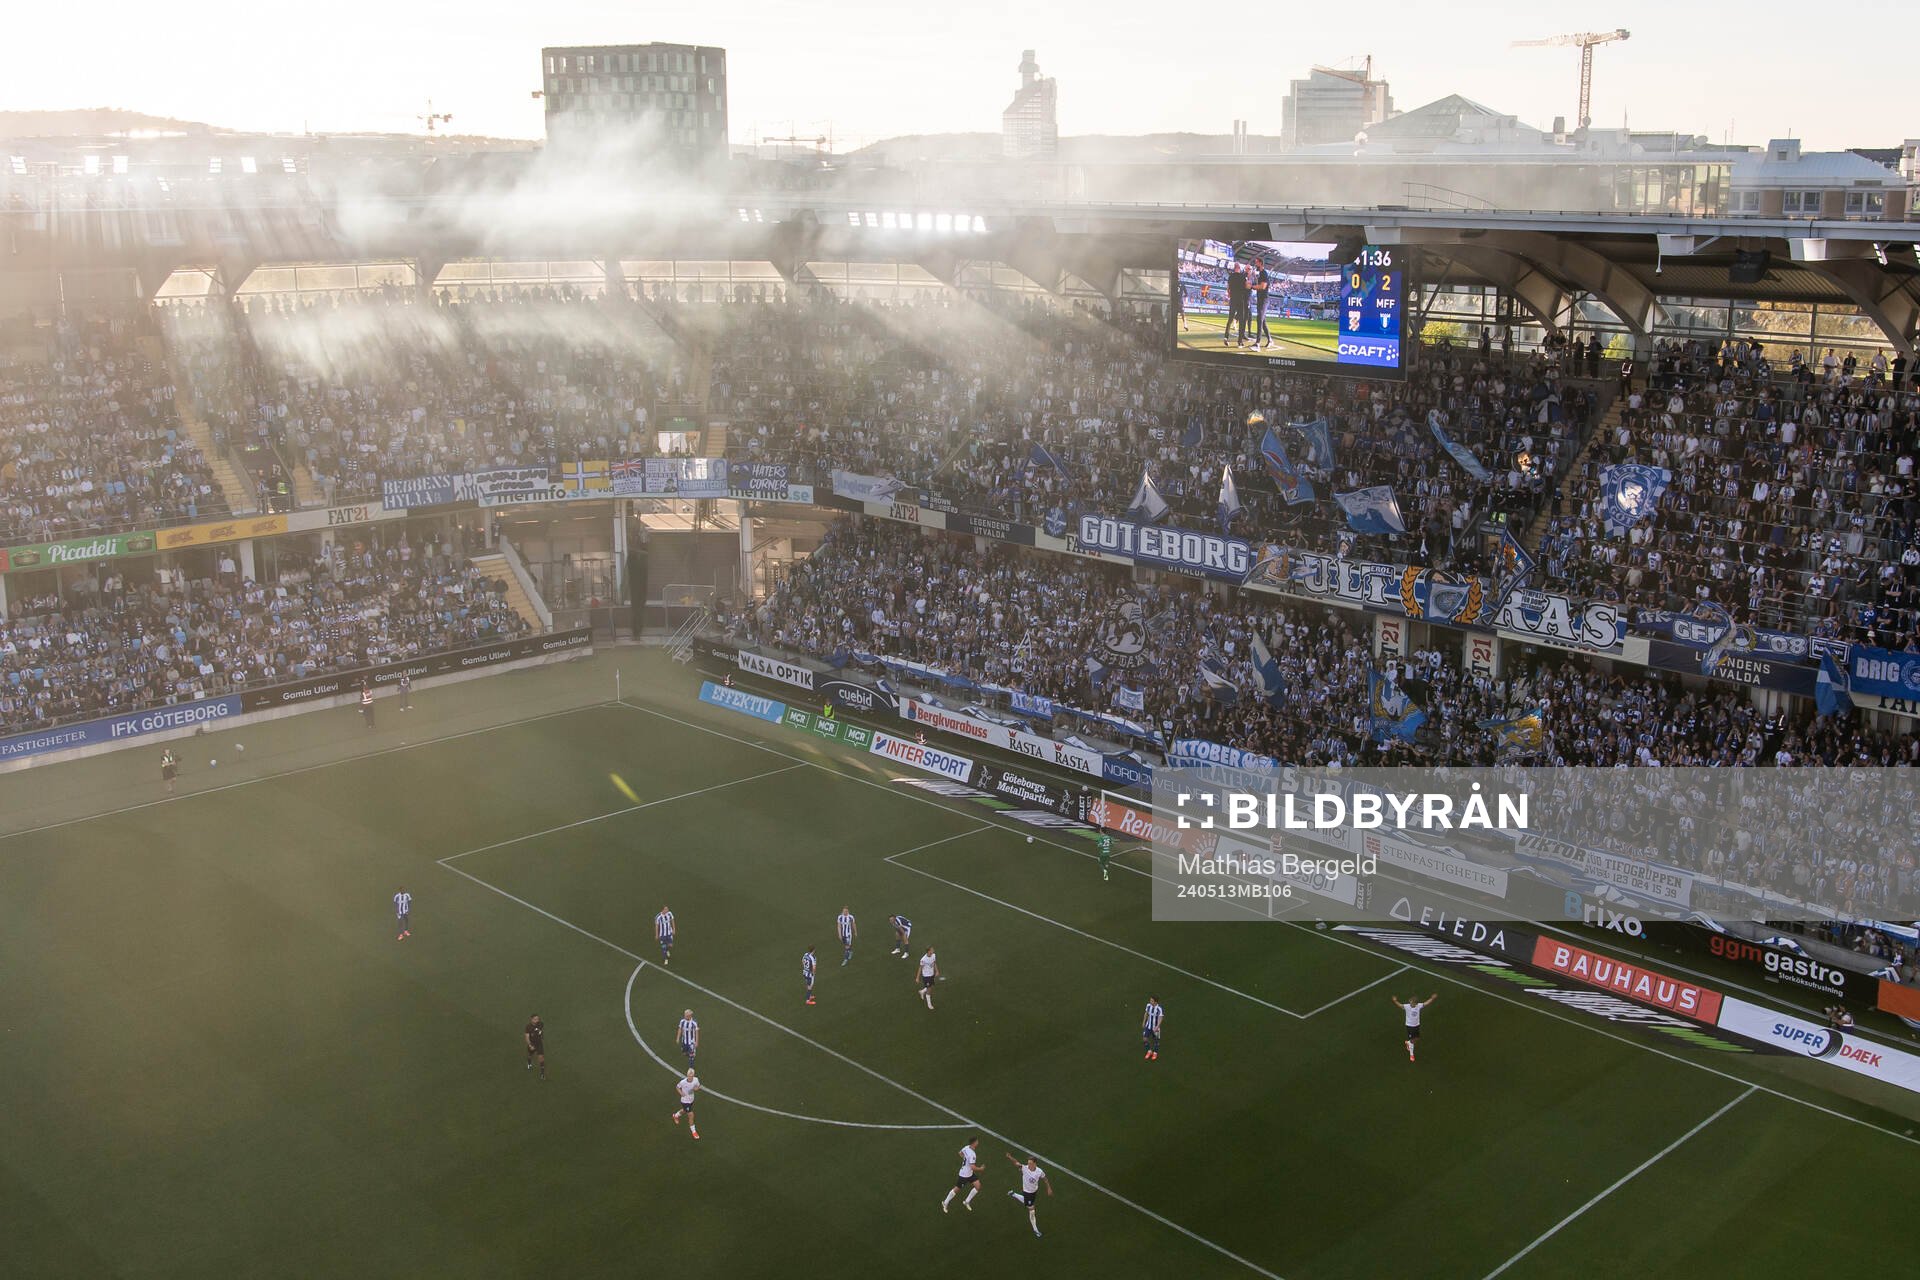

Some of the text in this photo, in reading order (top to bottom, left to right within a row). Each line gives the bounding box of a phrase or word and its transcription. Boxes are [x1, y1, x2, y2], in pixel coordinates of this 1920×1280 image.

[1351, 273, 1391, 291] 0 2
[1347, 297, 1396, 309] IFK MFF
[1268, 357, 1296, 367] SAMSUNG
[1338, 343, 1386, 358] CRAFT
[752, 463, 787, 476] HATERS
[383, 475, 451, 495] BEBBENS
[749, 477, 788, 490] CORNER
[326, 507, 370, 526] FAT21
[889, 503, 919, 522] FAT21
[969, 517, 1010, 532] LEGENDENS
[973, 527, 1006, 540] UTVALDA
[47, 538, 117, 563] Picadeli
[542, 633, 590, 650] Gamla Ullevi
[461, 648, 512, 666] Gamla Ullevi
[1695, 650, 1771, 675] LNDENS
[1855, 656, 1900, 683] BRIG
[374, 670, 403, 683] Gamla
[740, 654, 813, 687] WASA OPTIK
[282, 681, 339, 701] Gamla Ullevi
[711, 686, 774, 715] EFFEKTIV
[838, 687, 873, 708] cuebid
[111, 701, 229, 738] IFK GÖTEBORG
[789, 710, 806, 724] MCR
[817, 719, 835, 734] MCR
[917, 707, 988, 739] Bergkvarabuss
[1, 729, 87, 755] FASTIGHETER
[847, 728, 866, 742] MCR
[885, 740, 967, 777] INTERSPORT
[1009, 737, 1090, 773] RASTA RASTA
[996, 780, 1055, 807] Metallpartier
[1002, 771, 1045, 793] Göteborgs
[1119, 809, 1183, 849] Renova
[1518, 834, 1588, 863] VIKTOR
[1382, 844, 1496, 887] STENFASTIGHETER
[1605, 857, 1683, 889] TIFOGRUPPEN
[1612, 873, 1629, 885] 123
[1631, 878, 1648, 891] 024
[1665, 887, 1677, 899] 39
[1419, 906, 1506, 951] ELEDA
[1710, 935, 1845, 987] ggm gastro
[1553, 946, 1699, 1010] BAUHAUS
[1778, 971, 1844, 998] Storköksutrustning
[1772, 1023, 1824, 1049] SUPER
